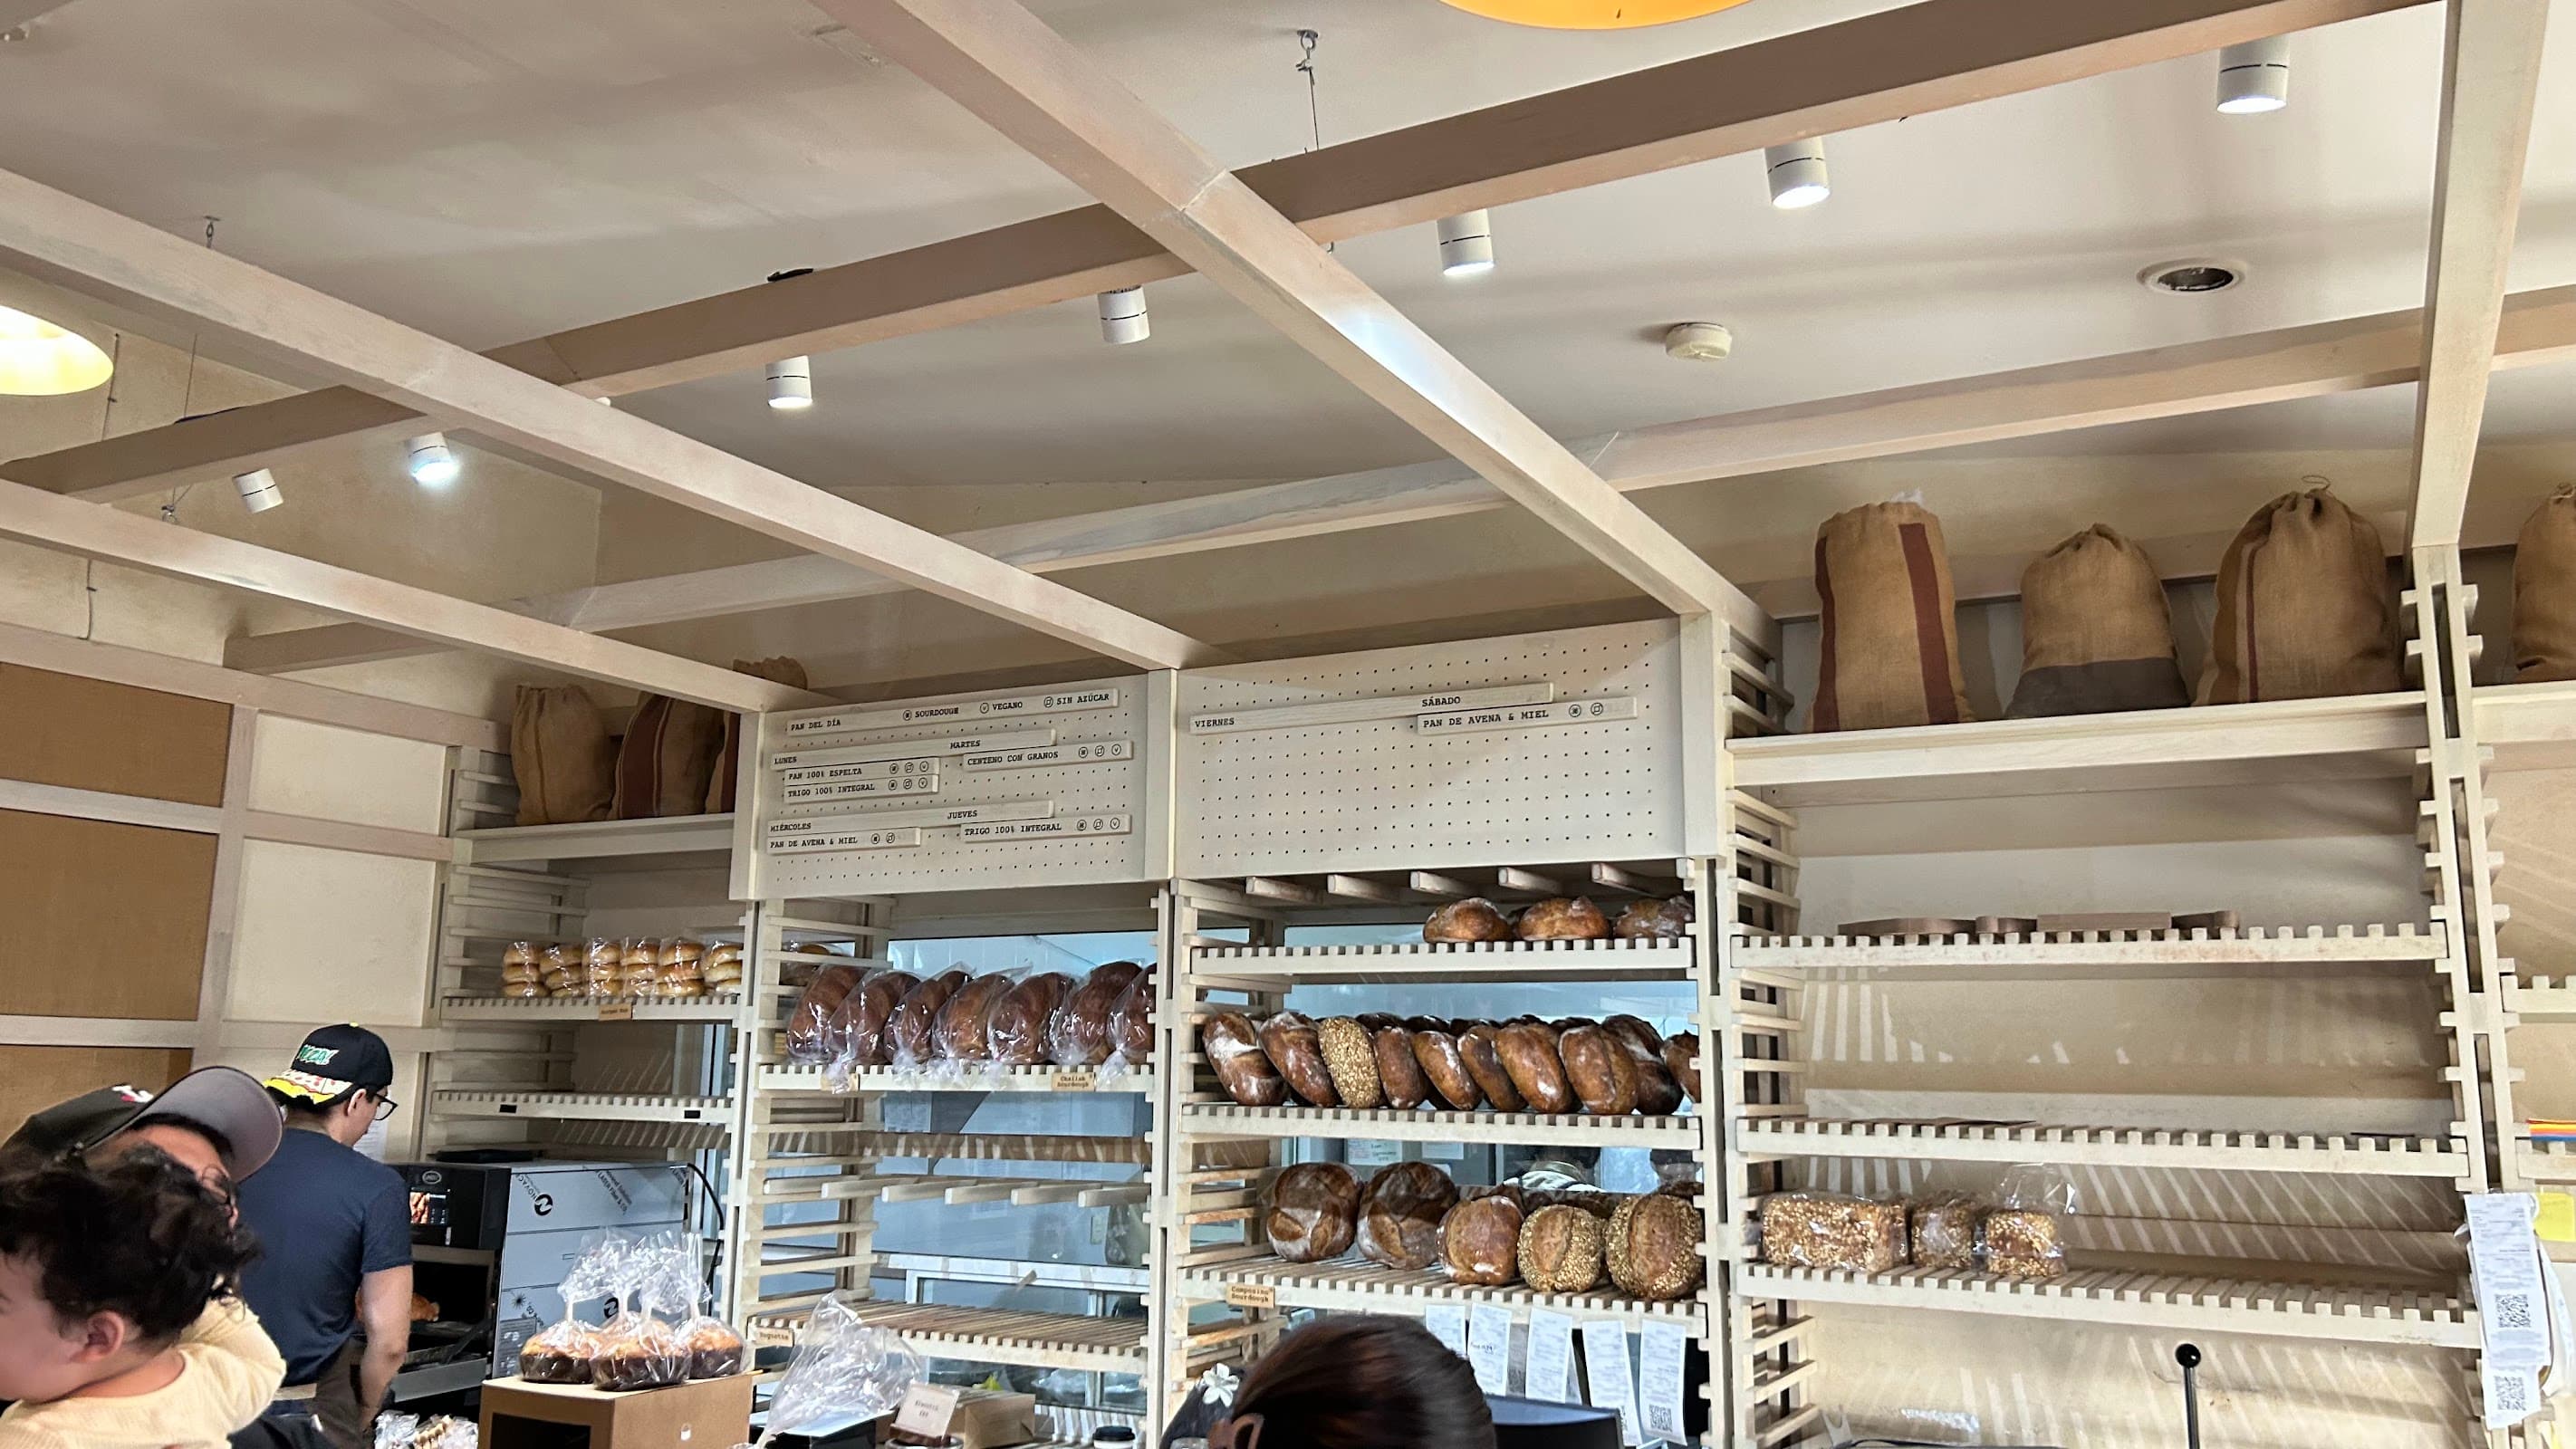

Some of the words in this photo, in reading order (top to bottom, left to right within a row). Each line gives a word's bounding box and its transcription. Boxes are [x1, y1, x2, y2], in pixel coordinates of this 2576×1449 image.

[1056, 696, 1072, 705] SIN
[1077, 692, 1110, 704] AZÚCAR
[1422, 696, 1461, 707] SÁBADO
[992, 702, 1023, 711] VEGANO
[915, 707, 958, 718] SOURDOUGH
[791, 723, 804, 731] PAN
[809, 721, 822, 729] DEL
[826, 718, 841, 727] DÍA
[1195, 717, 1235, 727] VIERNES
[1423, 719, 1442, 728] PAN
[1449, 717, 1462, 725] DE
[1468, 715, 1501, 724] AVENA
[1521, 710, 1549, 720] MIEL
[950, 740, 981, 750] MARTES
[774, 756, 797, 764] LUNES
[967, 756, 1003, 765] CENTENO
[1007, 753, 1023, 762] CON
[1027, 752, 1059, 761] GRANOS
[806, 771, 824, 779] 100%
[830, 768, 862, 777] ESPELTA
[788, 789, 811, 797] TRIGO
[815, 787, 833, 795] 100%
[838, 784, 875, 793] INTEGRAL
[947, 811, 977, 820] JUEVES
[770, 822, 812, 832] MIÉRCOLES
[965, 827, 990, 836] TRIGO
[995, 825, 1014, 834] 100%
[1021, 822, 1062, 832] INTEGRAL
[770, 840, 784, 849] PAN
[788, 840, 798, 848] DE
[802, 838, 825, 846] AVENA
[838, 837, 858, 845] MIEL
